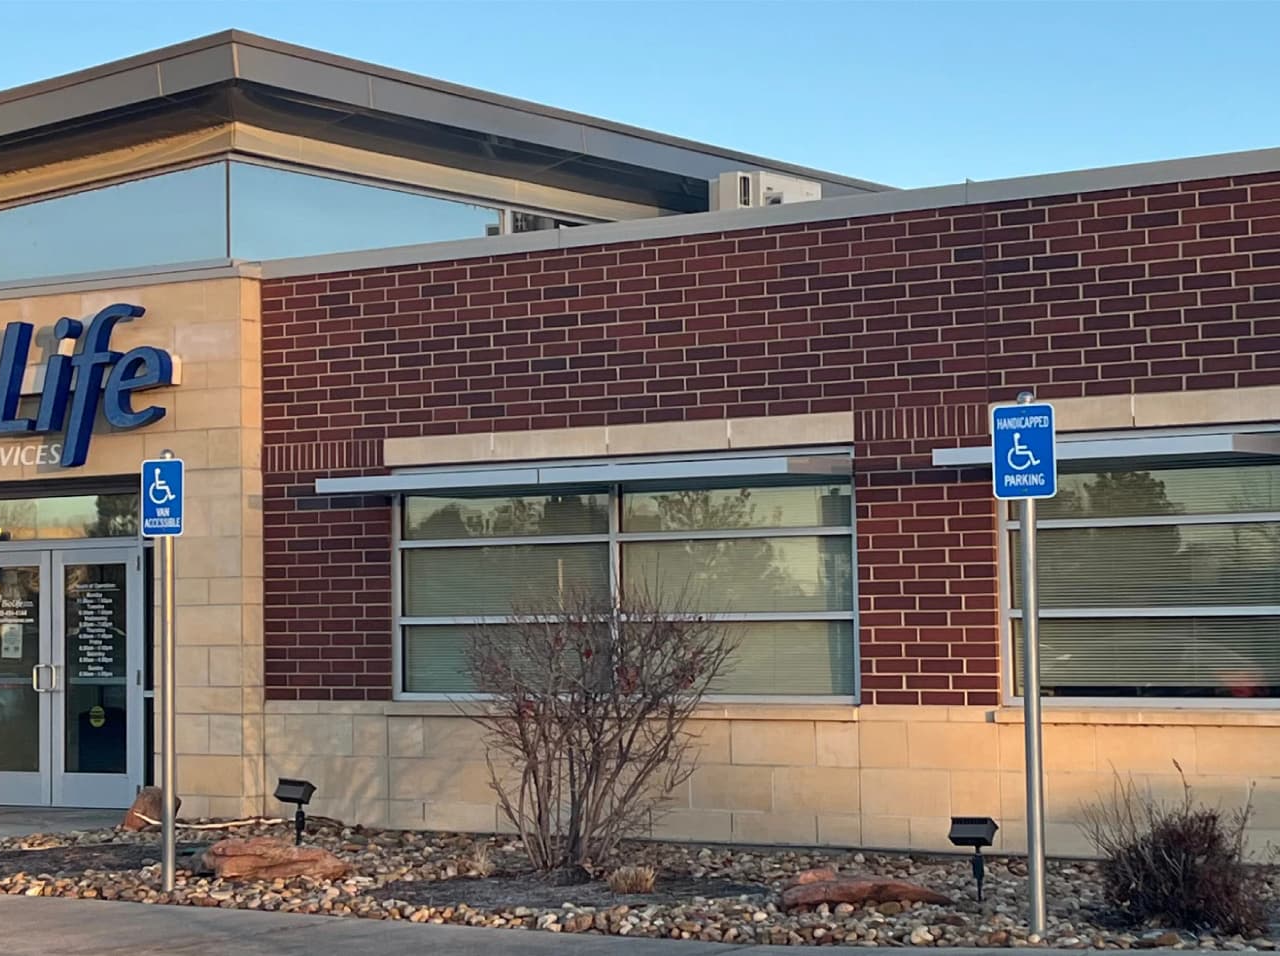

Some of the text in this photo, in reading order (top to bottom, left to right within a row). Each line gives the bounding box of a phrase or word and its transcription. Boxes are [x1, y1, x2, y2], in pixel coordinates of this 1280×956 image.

[996, 415, 1050, 430] HANDICAPPED
[1003, 472, 1046, 487] PARKING
[155, 507, 170, 517] VAN
[144, 517, 181, 528] ACCESSIBLE
